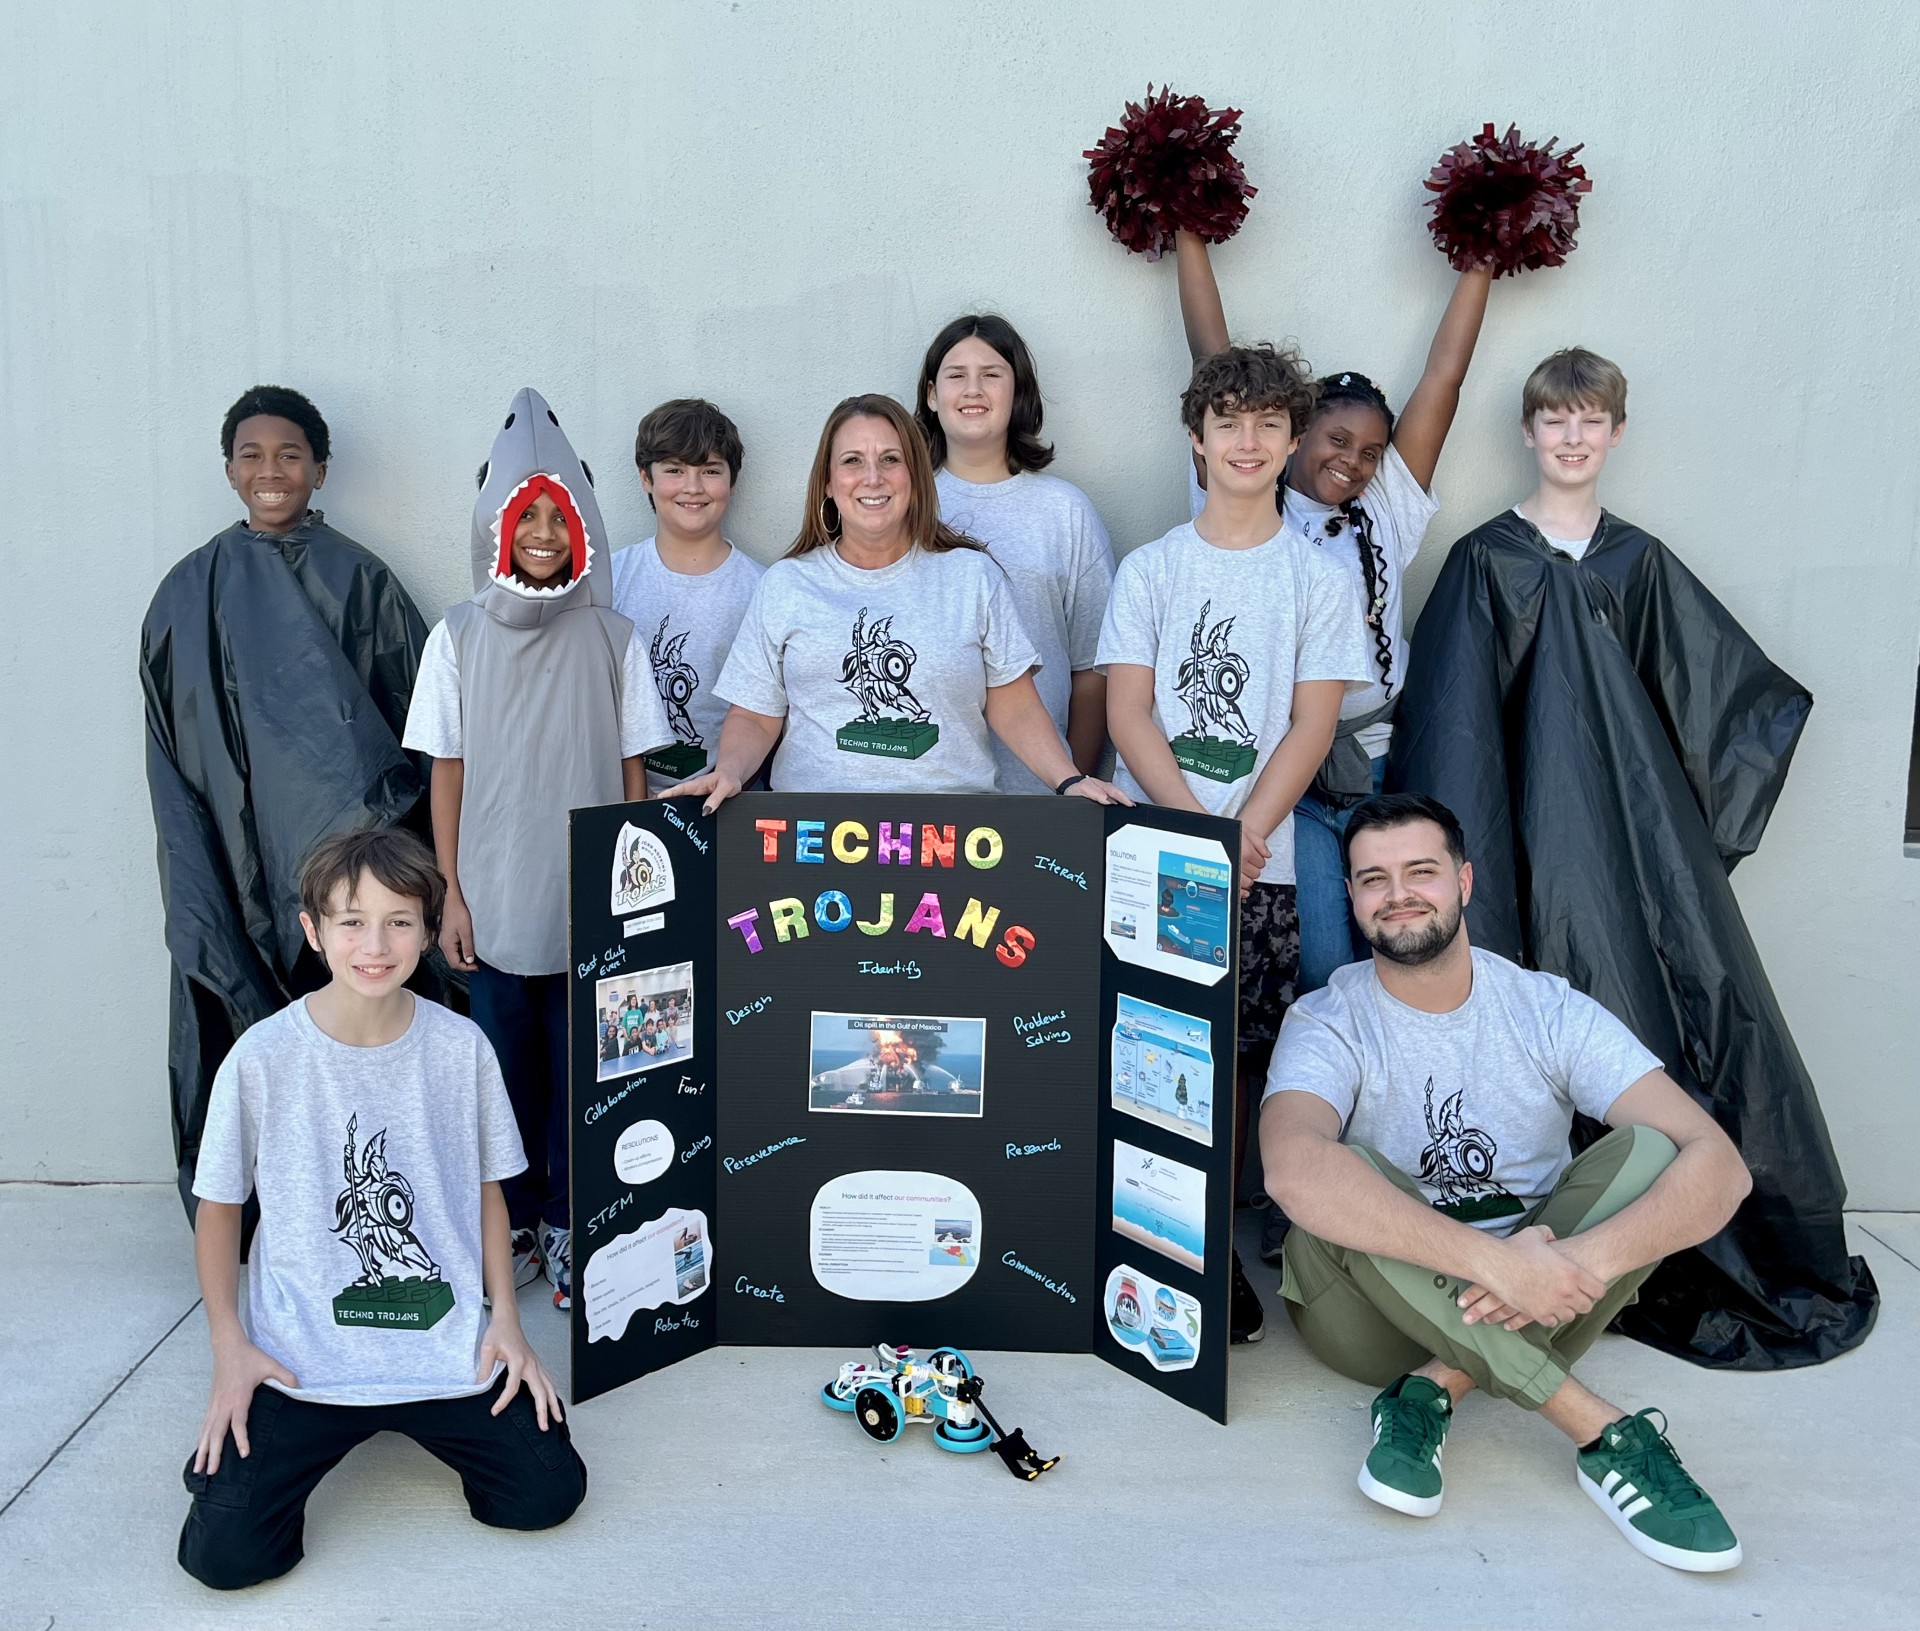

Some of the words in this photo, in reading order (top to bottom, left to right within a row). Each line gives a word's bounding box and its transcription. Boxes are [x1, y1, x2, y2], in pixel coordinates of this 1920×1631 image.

[839, 738, 869, 748] TECHNO
[871, 742, 908, 752] TROJANS
[649, 758, 678, 773] TROJANS
[1197, 761, 1230, 777] TROJANS
[662, 803, 685, 831] Team
[686, 822, 709, 855] Work
[755, 819, 1003, 869] TECHNO
[1110, 850, 1137, 861] SOLUTIONS
[615, 874, 667, 906] TROJANS
[727, 890, 1036, 968] TROJANS
[577, 953, 597, 979] Best
[604, 944, 626, 962] Club
[857, 959, 922, 979] Identify
[725, 995, 773, 1026] Design
[1013, 1009, 1067, 1036] Problems
[864, 1021, 878, 1029] spill
[621, 1134, 659, 1151] RESOLUTIONS
[681, 1135, 712, 1164] Coding
[1005, 1137, 1062, 1160] Research
[841, 1192, 857, 1200] How
[906, 1195, 952, 1203] communities?
[587, 1192, 633, 1236] STEM
[606, 1249, 619, 1261] How
[619, 1245, 628, 1254] did
[632, 1236, 647, 1248] affect
[735, 1275, 786, 1303] Create
[1001, 1250, 1077, 1304] Communication
[337, 1310, 374, 1320] TECHNO
[377, 1311, 420, 1321] TROJANS
[653, 1311, 700, 1336] Robotics
